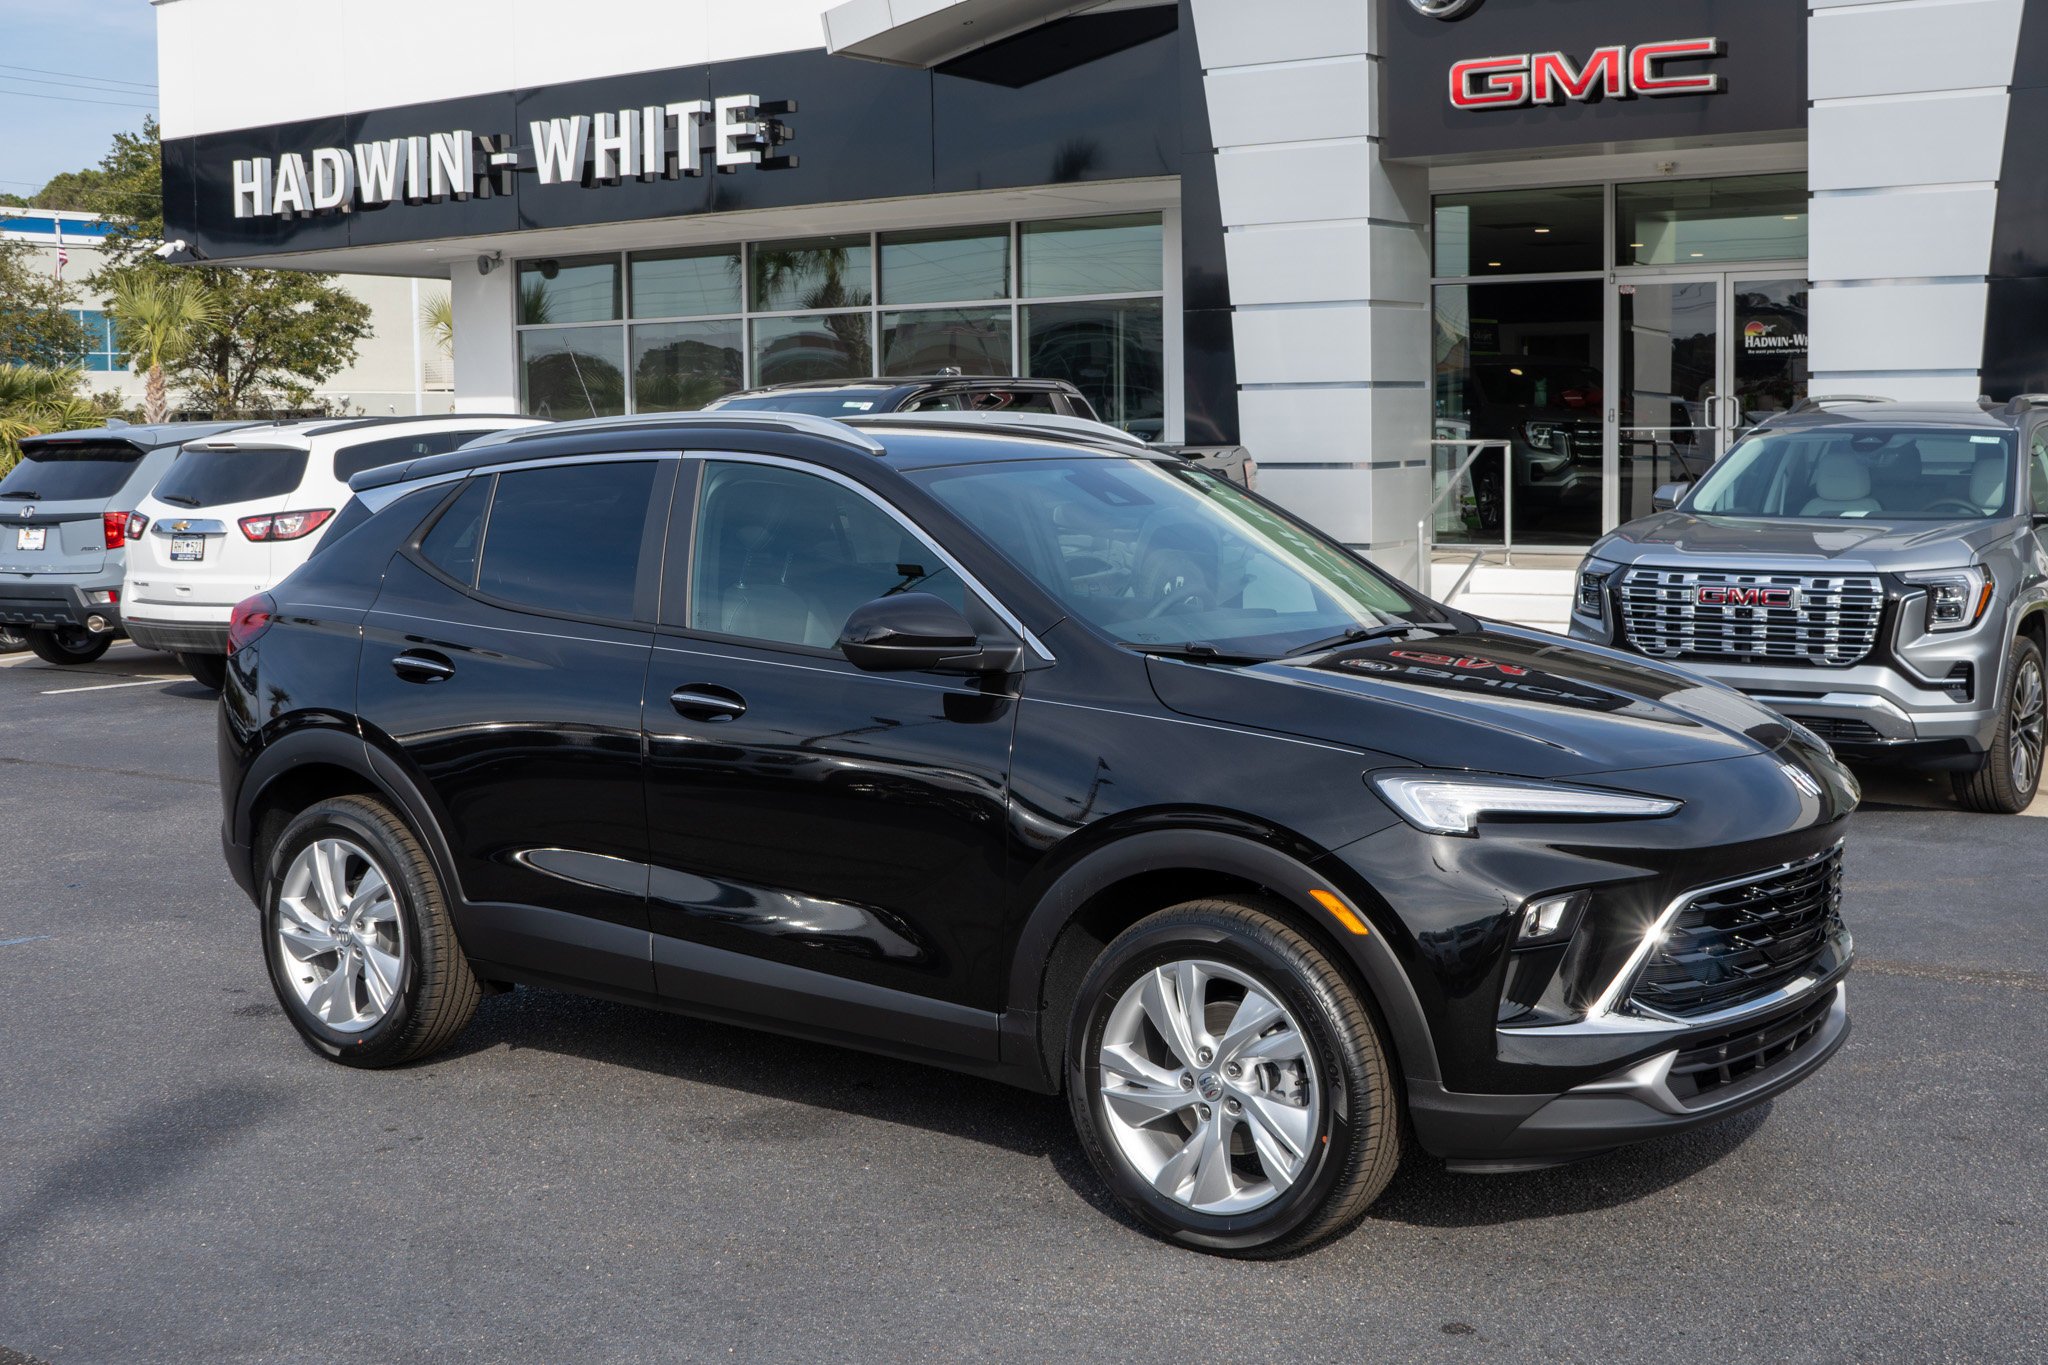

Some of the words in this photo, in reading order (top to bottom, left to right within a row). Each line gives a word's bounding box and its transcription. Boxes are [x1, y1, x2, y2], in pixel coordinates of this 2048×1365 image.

[1449, 37, 1717, 109] GMC
[233, 130, 473, 218] HADWIN
[530, 94, 761, 184] WHITE
[1699, 586, 1791, 607] GMC
